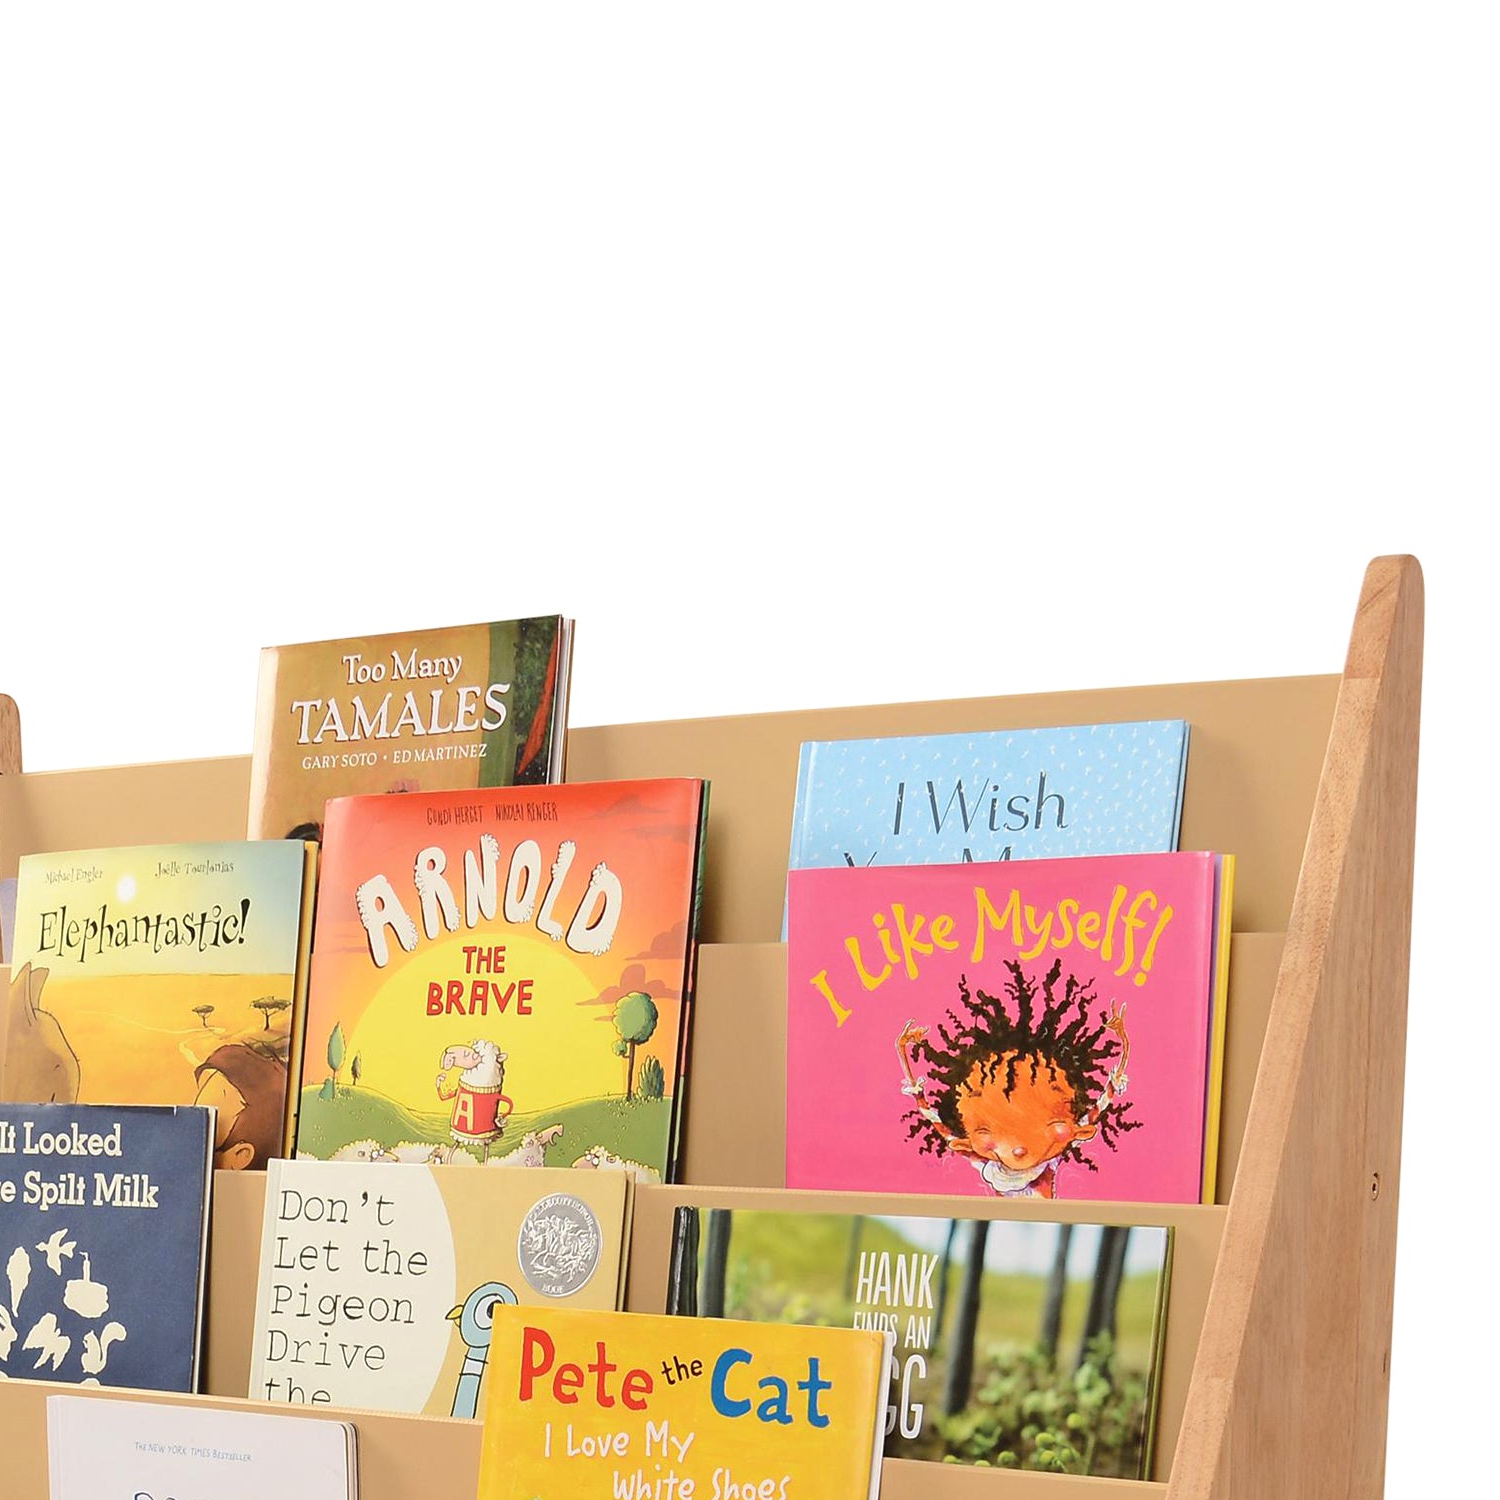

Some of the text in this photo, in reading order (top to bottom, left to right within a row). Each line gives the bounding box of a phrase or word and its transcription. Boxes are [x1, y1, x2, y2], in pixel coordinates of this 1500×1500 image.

[342, 648, 462, 685] Too Many
[290, 682, 511, 745] TAMALES
[301, 743, 488, 770] GARY SOTO ED MARTINEZ
[893, 770, 1069, 836] I Wish
[356, 833, 622, 967] ARNOLD
[37, 898, 251, 963] Elephantastic!
[462, 945, 506, 974] THE
[810, 884, 1174, 1028] I Like Myself!
[426, 979, 534, 1016] BRAVE
[454, 1094, 475, 1131] A
[23, 1122, 122, 1157] Looked
[23, 1170, 86, 1211] Spilt
[92, 1173, 159, 1208] Milk
[278, 1190, 395, 1227] Don't
[274, 1236, 429, 1276] Let the
[855, 1251, 939, 1309] HANK
[271, 1282, 415, 1326] Pigeon
[265, 1329, 386, 1371] Drive
[904, 1314, 931, 1349] AN
[265, 1377, 331, 1405] the
[518, 1326, 654, 1411] Pete
[661, 1354, 703, 1386] the
[710, 1347, 833, 1428] Cat
[543, 1420, 695, 1463] I Love My
